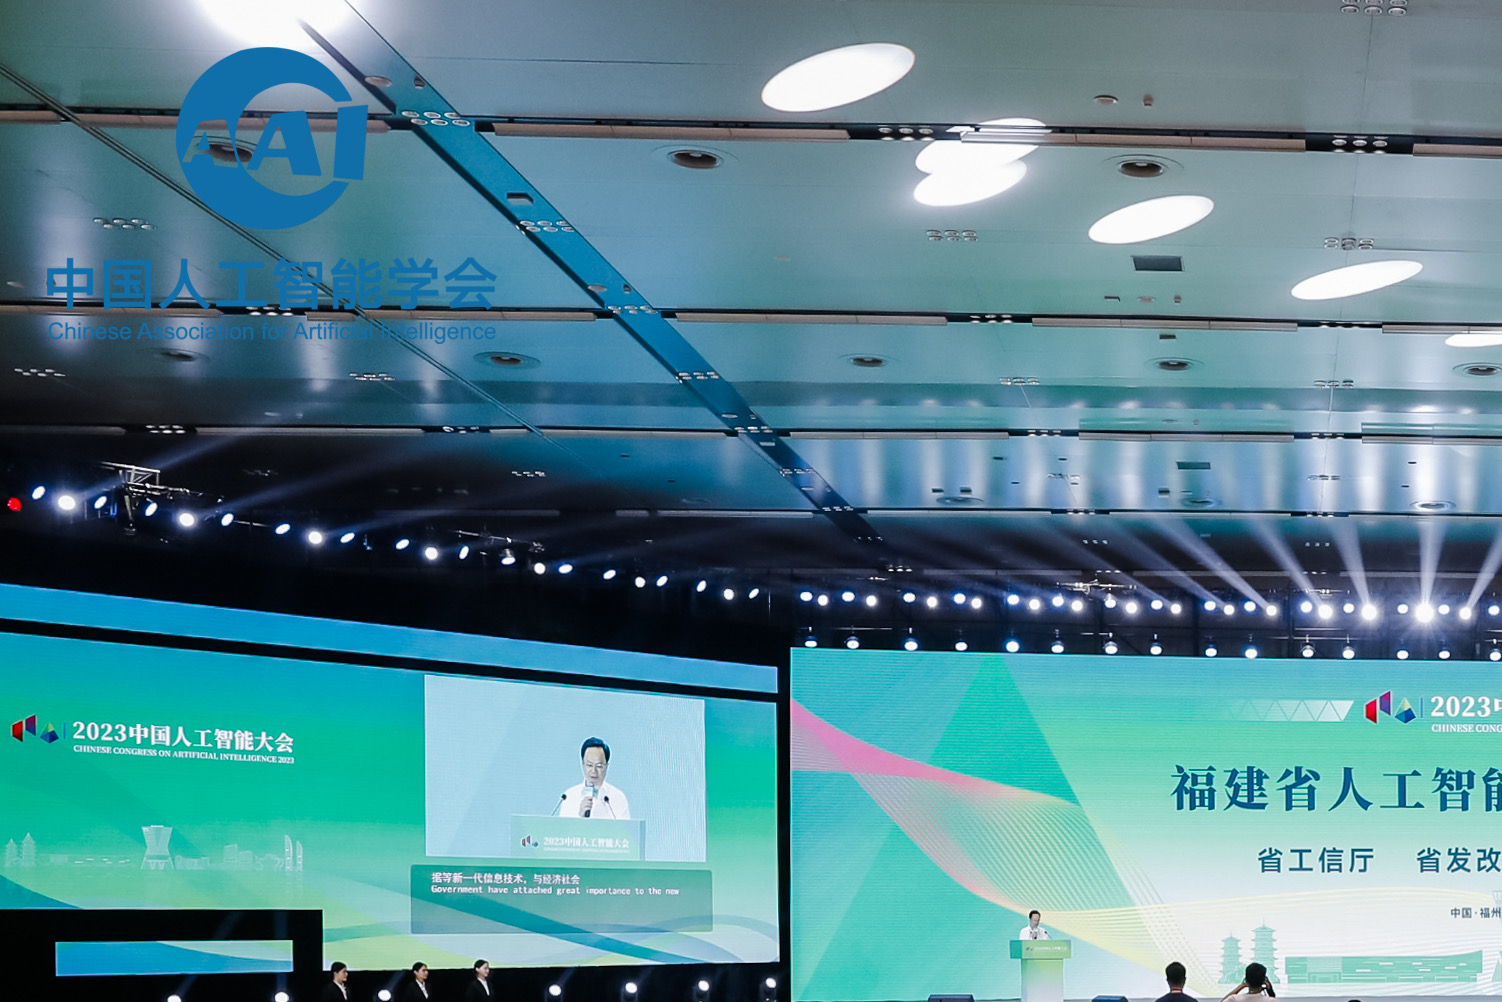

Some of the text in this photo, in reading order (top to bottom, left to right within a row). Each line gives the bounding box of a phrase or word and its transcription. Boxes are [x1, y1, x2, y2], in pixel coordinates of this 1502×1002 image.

[1431, 724, 1474, 733] CHINESE
[72, 721, 294, 753] 2023中国人工智能大会
[73, 745, 112, 754] CHINESE
[113, 747, 157, 756] CONGRESS
[1257, 847, 1374, 873] 省工信厅
[431, 885, 483, 894] Government
[488, 886, 509, 894] have
[513, 886, 552, 895] attached
[556, 887, 581, 896] great
[586, 887, 631, 896] importance
